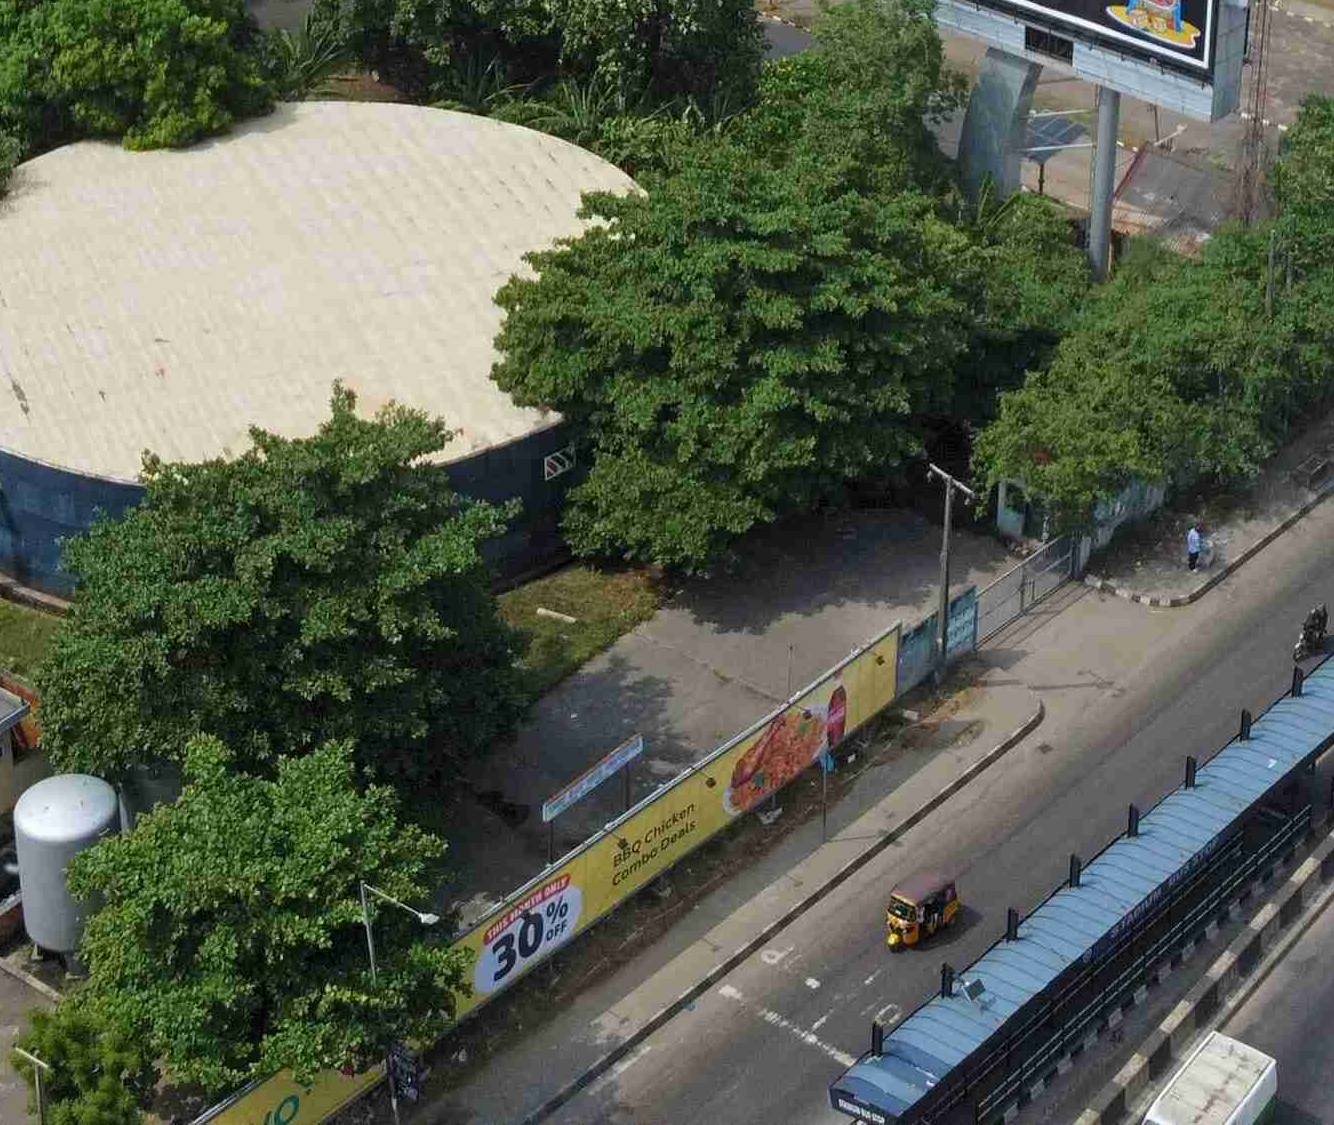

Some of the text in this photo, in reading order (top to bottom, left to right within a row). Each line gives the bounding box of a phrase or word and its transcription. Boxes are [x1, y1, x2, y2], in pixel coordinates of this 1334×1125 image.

[612, 820, 697, 886] Combo Deals
[613, 803, 695, 868] BBQ Chicken
[487, 920, 509, 941] THIS
[543, 876, 568, 897] ONLY
[547, 919, 567, 941] OFF
